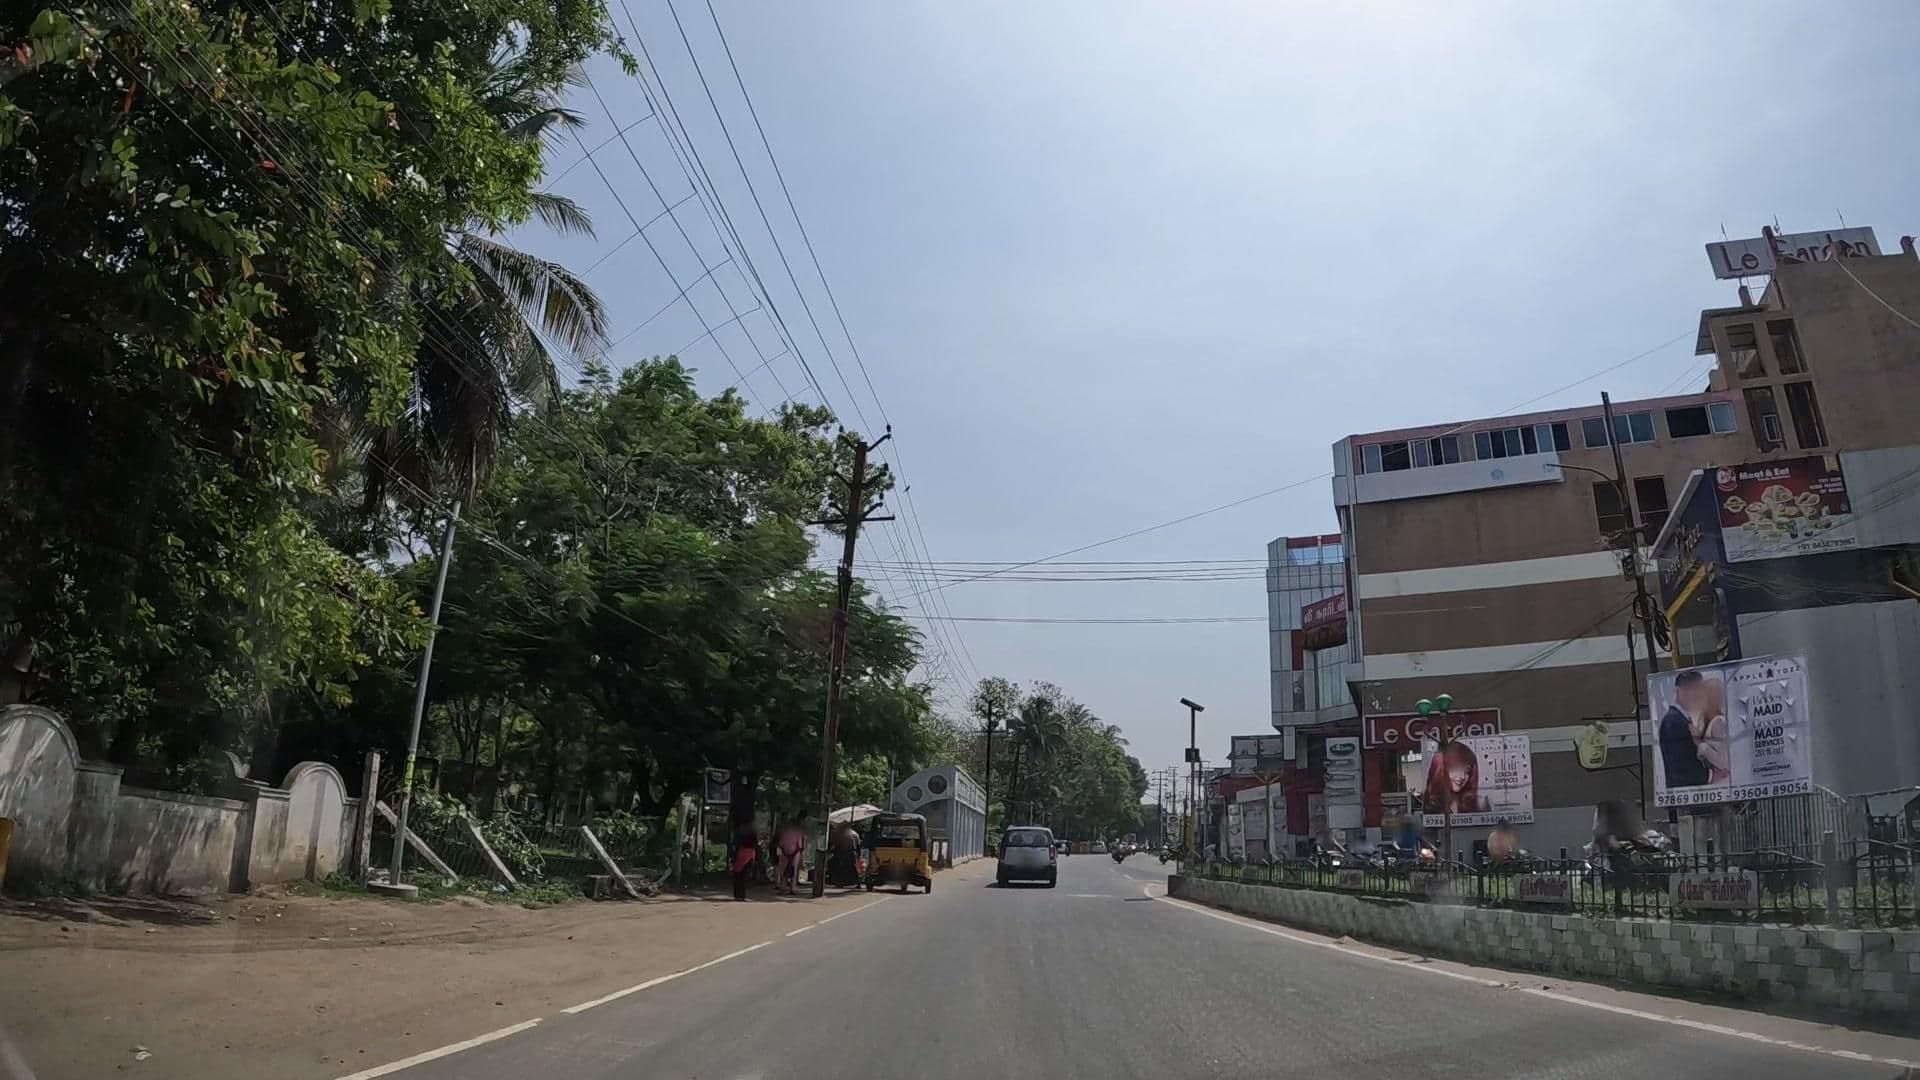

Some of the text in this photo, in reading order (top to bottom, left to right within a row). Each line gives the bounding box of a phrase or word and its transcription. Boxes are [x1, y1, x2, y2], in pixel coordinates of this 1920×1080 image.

[1720, 245, 1760, 271] Le
[1733, 665, 1801, 682] APPLE TOZZ
[1753, 703, 1784, 718] MAID
[1371, 720, 1399, 745] Le
[1754, 726, 1785, 741] MAID
[1754, 738, 1785, 749] SERVICES
[1658, 791, 1689, 807] 97869
[1692, 790, 1723, 804] 01105
[1734, 786, 1769, 801] 93604
[1772, 782, 1809, 795] 89054
